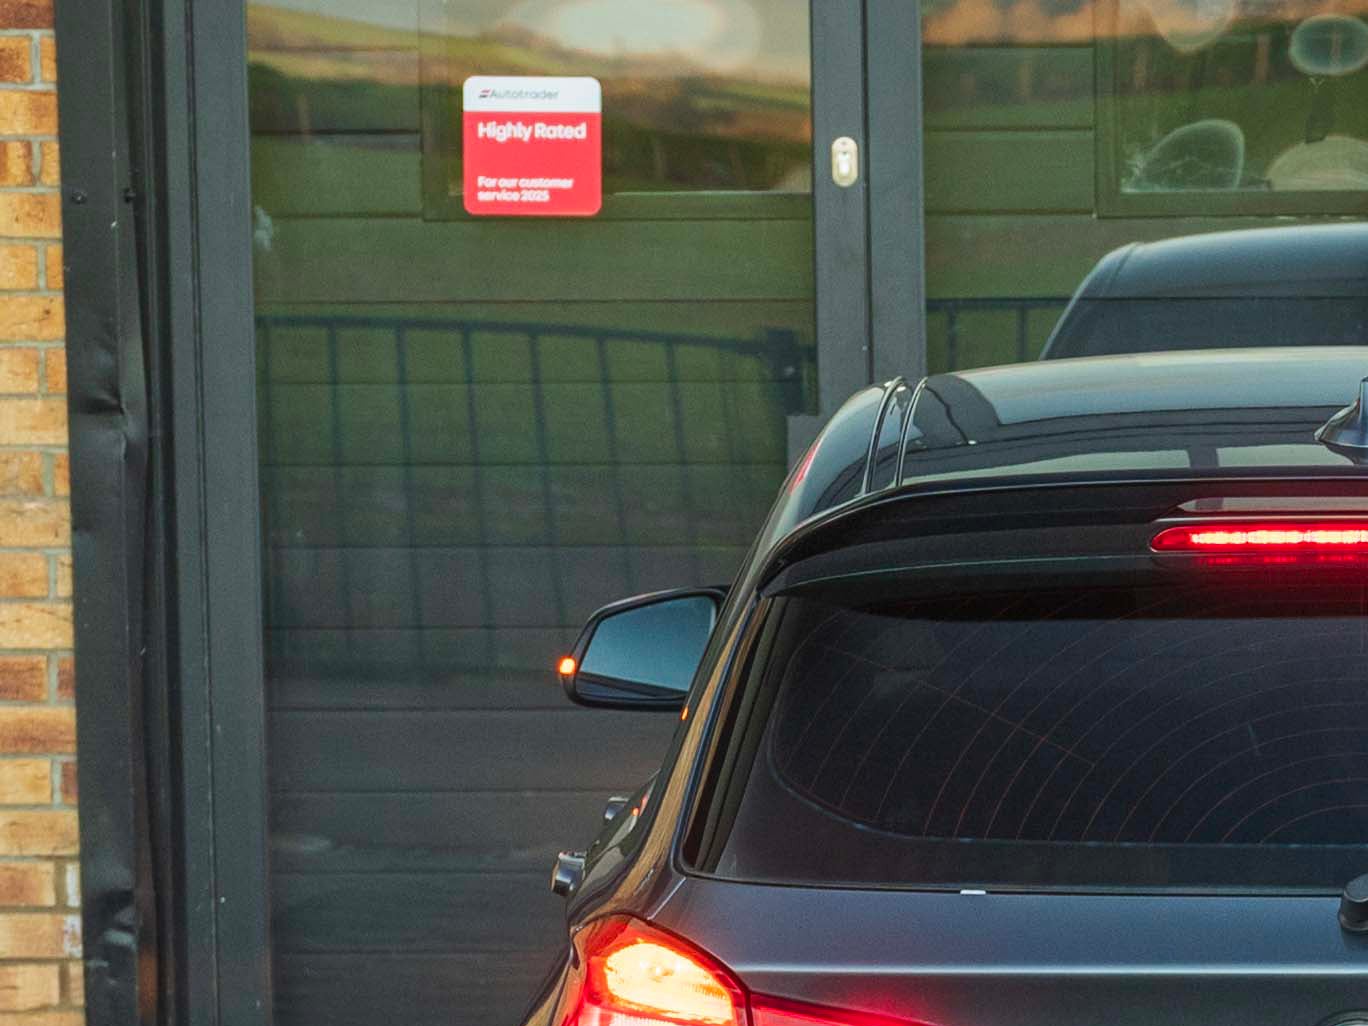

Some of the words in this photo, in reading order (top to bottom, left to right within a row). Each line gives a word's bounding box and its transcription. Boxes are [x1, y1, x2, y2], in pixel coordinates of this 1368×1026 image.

[490, 88, 559, 99] Autotrader
[477, 121, 533, 142] Highly
[534, 122, 587, 140] Rated
[477, 176, 497, 188] For
[498, 178, 518, 188] our
[518, 178, 574, 189] customer
[477, 190, 519, 202] service
